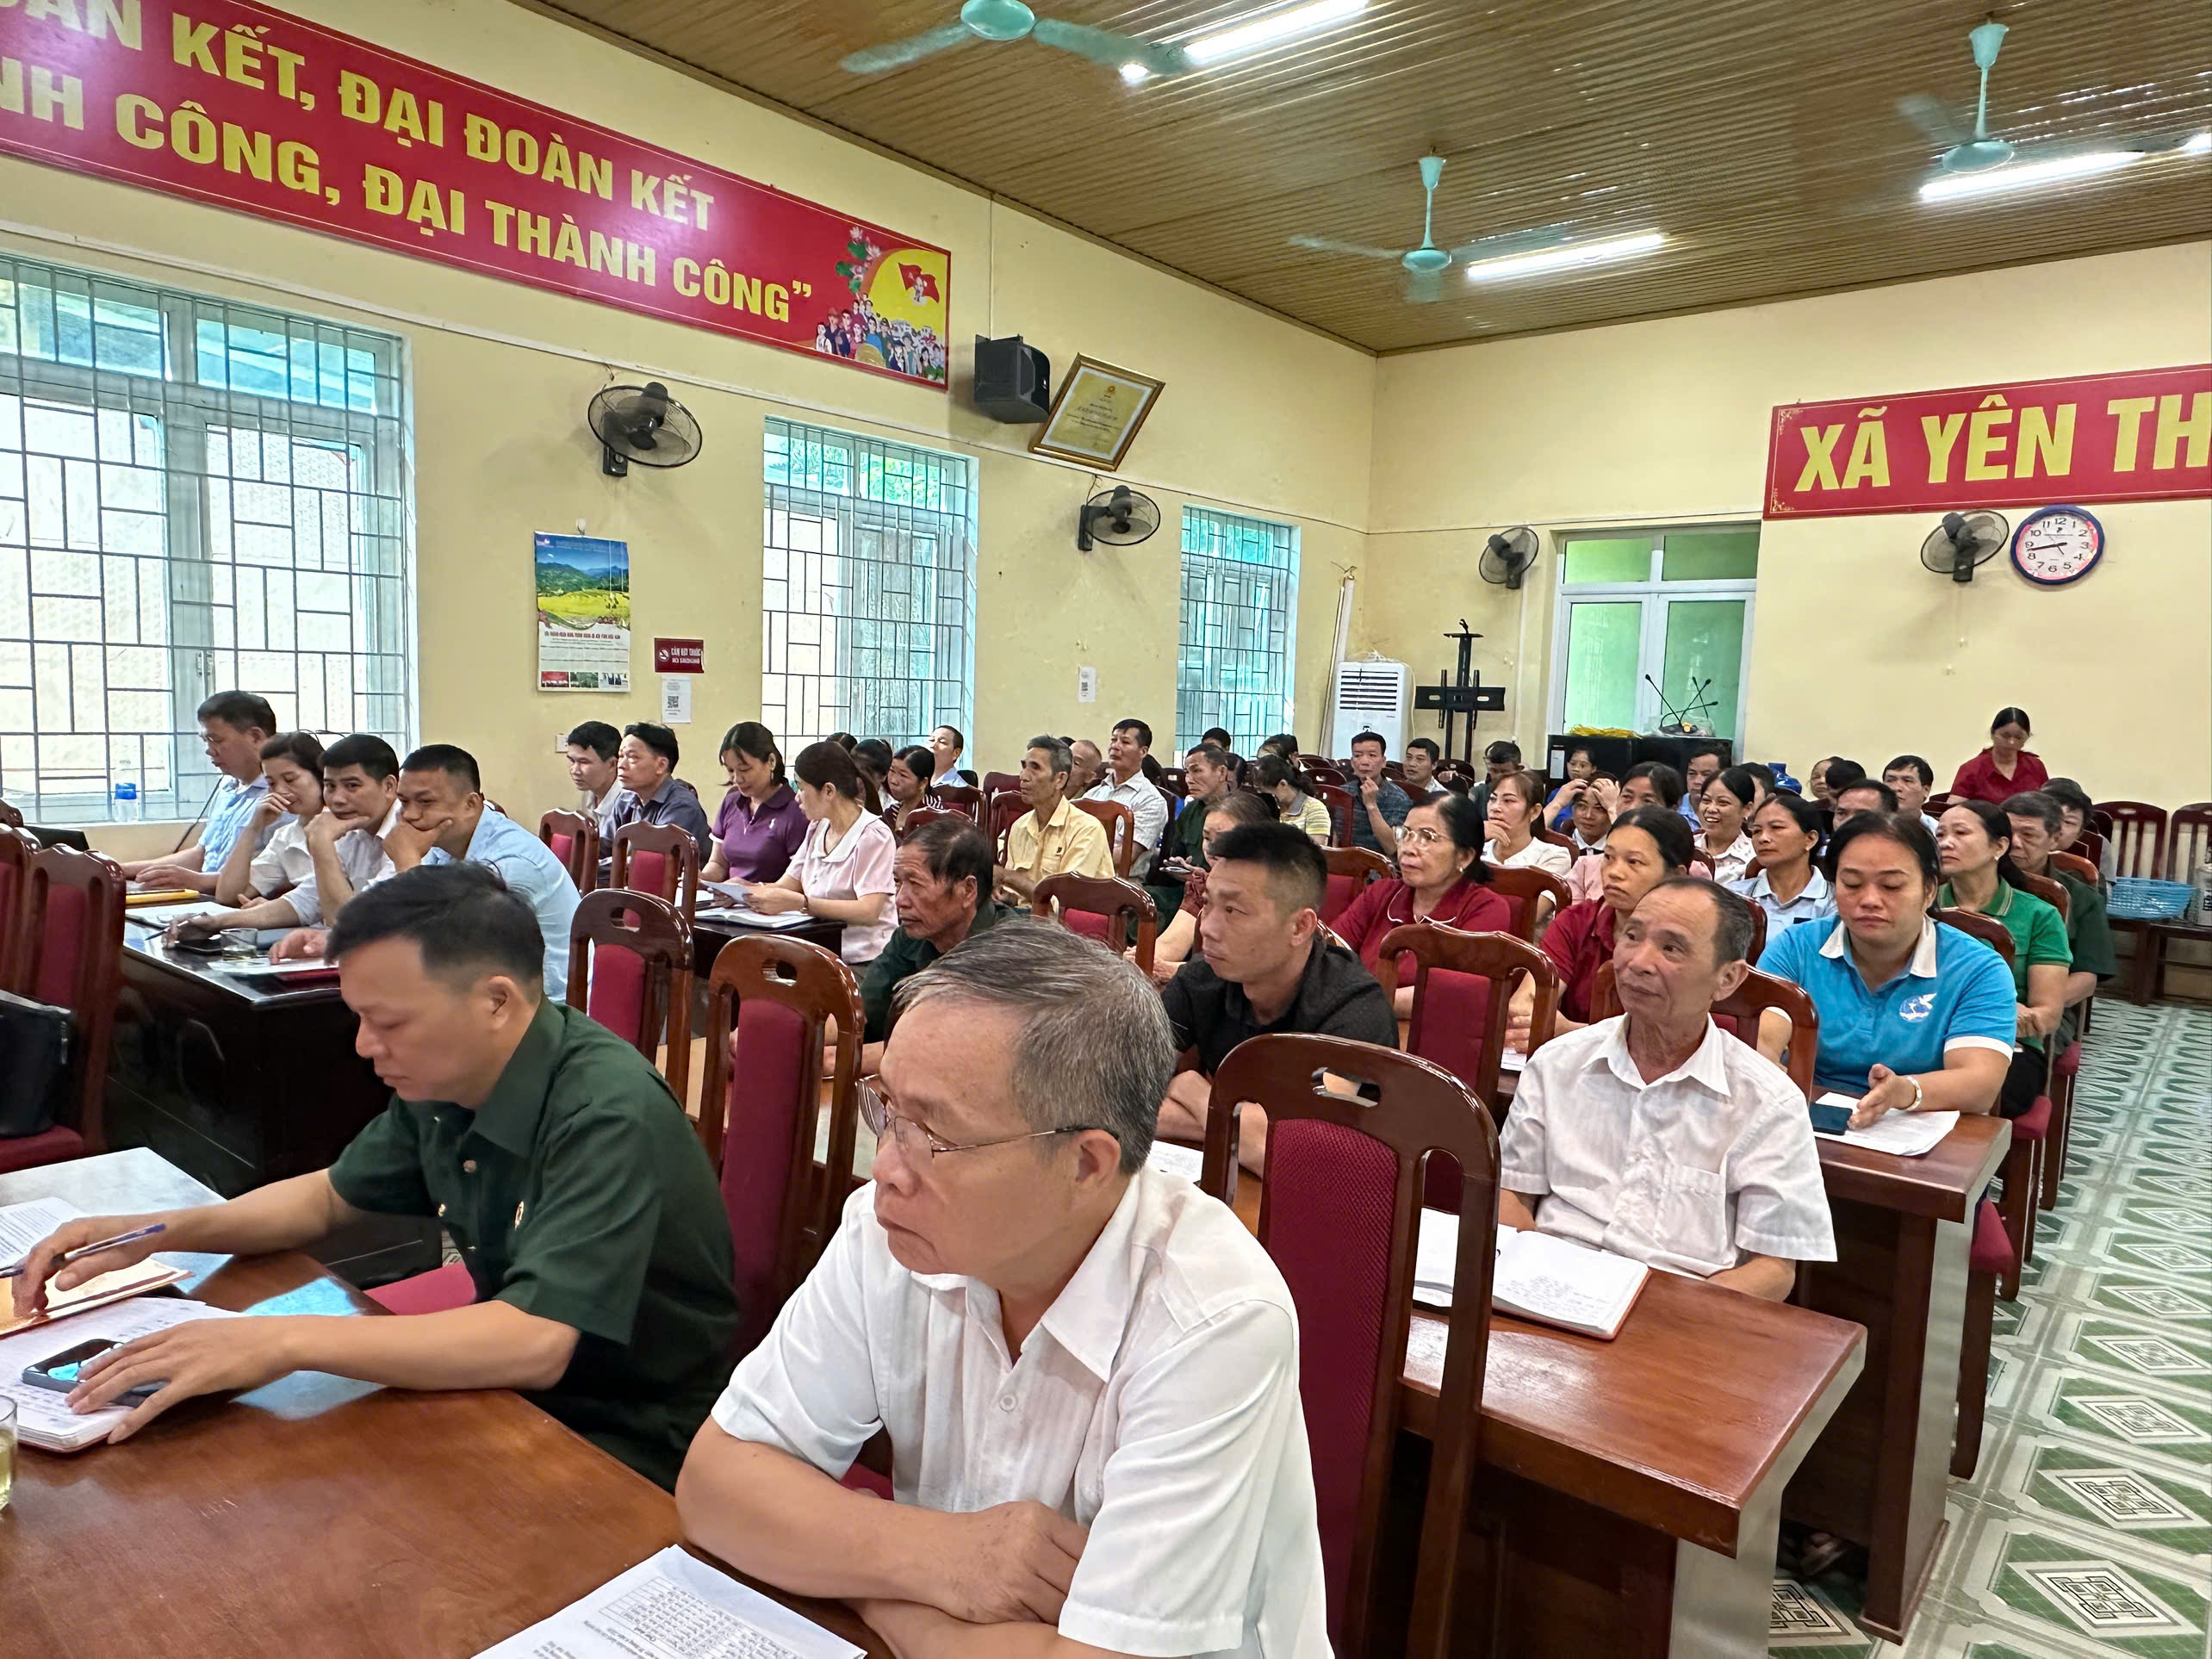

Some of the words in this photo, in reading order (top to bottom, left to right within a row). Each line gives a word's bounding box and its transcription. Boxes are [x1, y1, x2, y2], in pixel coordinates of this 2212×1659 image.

[173, 12, 315, 111] KẾT,
[338, 70, 444, 148] ĐẠI
[463, 113, 613, 202] ĐOÀN
[631, 169, 714, 231] KẾT
[116, 94, 340, 206] CÔNG,
[363, 164, 465, 237] ĐẠI
[486, 199, 656, 286] THÀNH
[1794, 406, 1891, 493] XÃ
[1922, 394, 2077, 484] YÊN
[2107, 391, 2212, 472] TH
[2042, 520, 2051, 529] 11
[2078, 529, 2089, 537] 2
[2080, 541, 2090, 550] 3
[2036, 561, 2045, 569] 7
